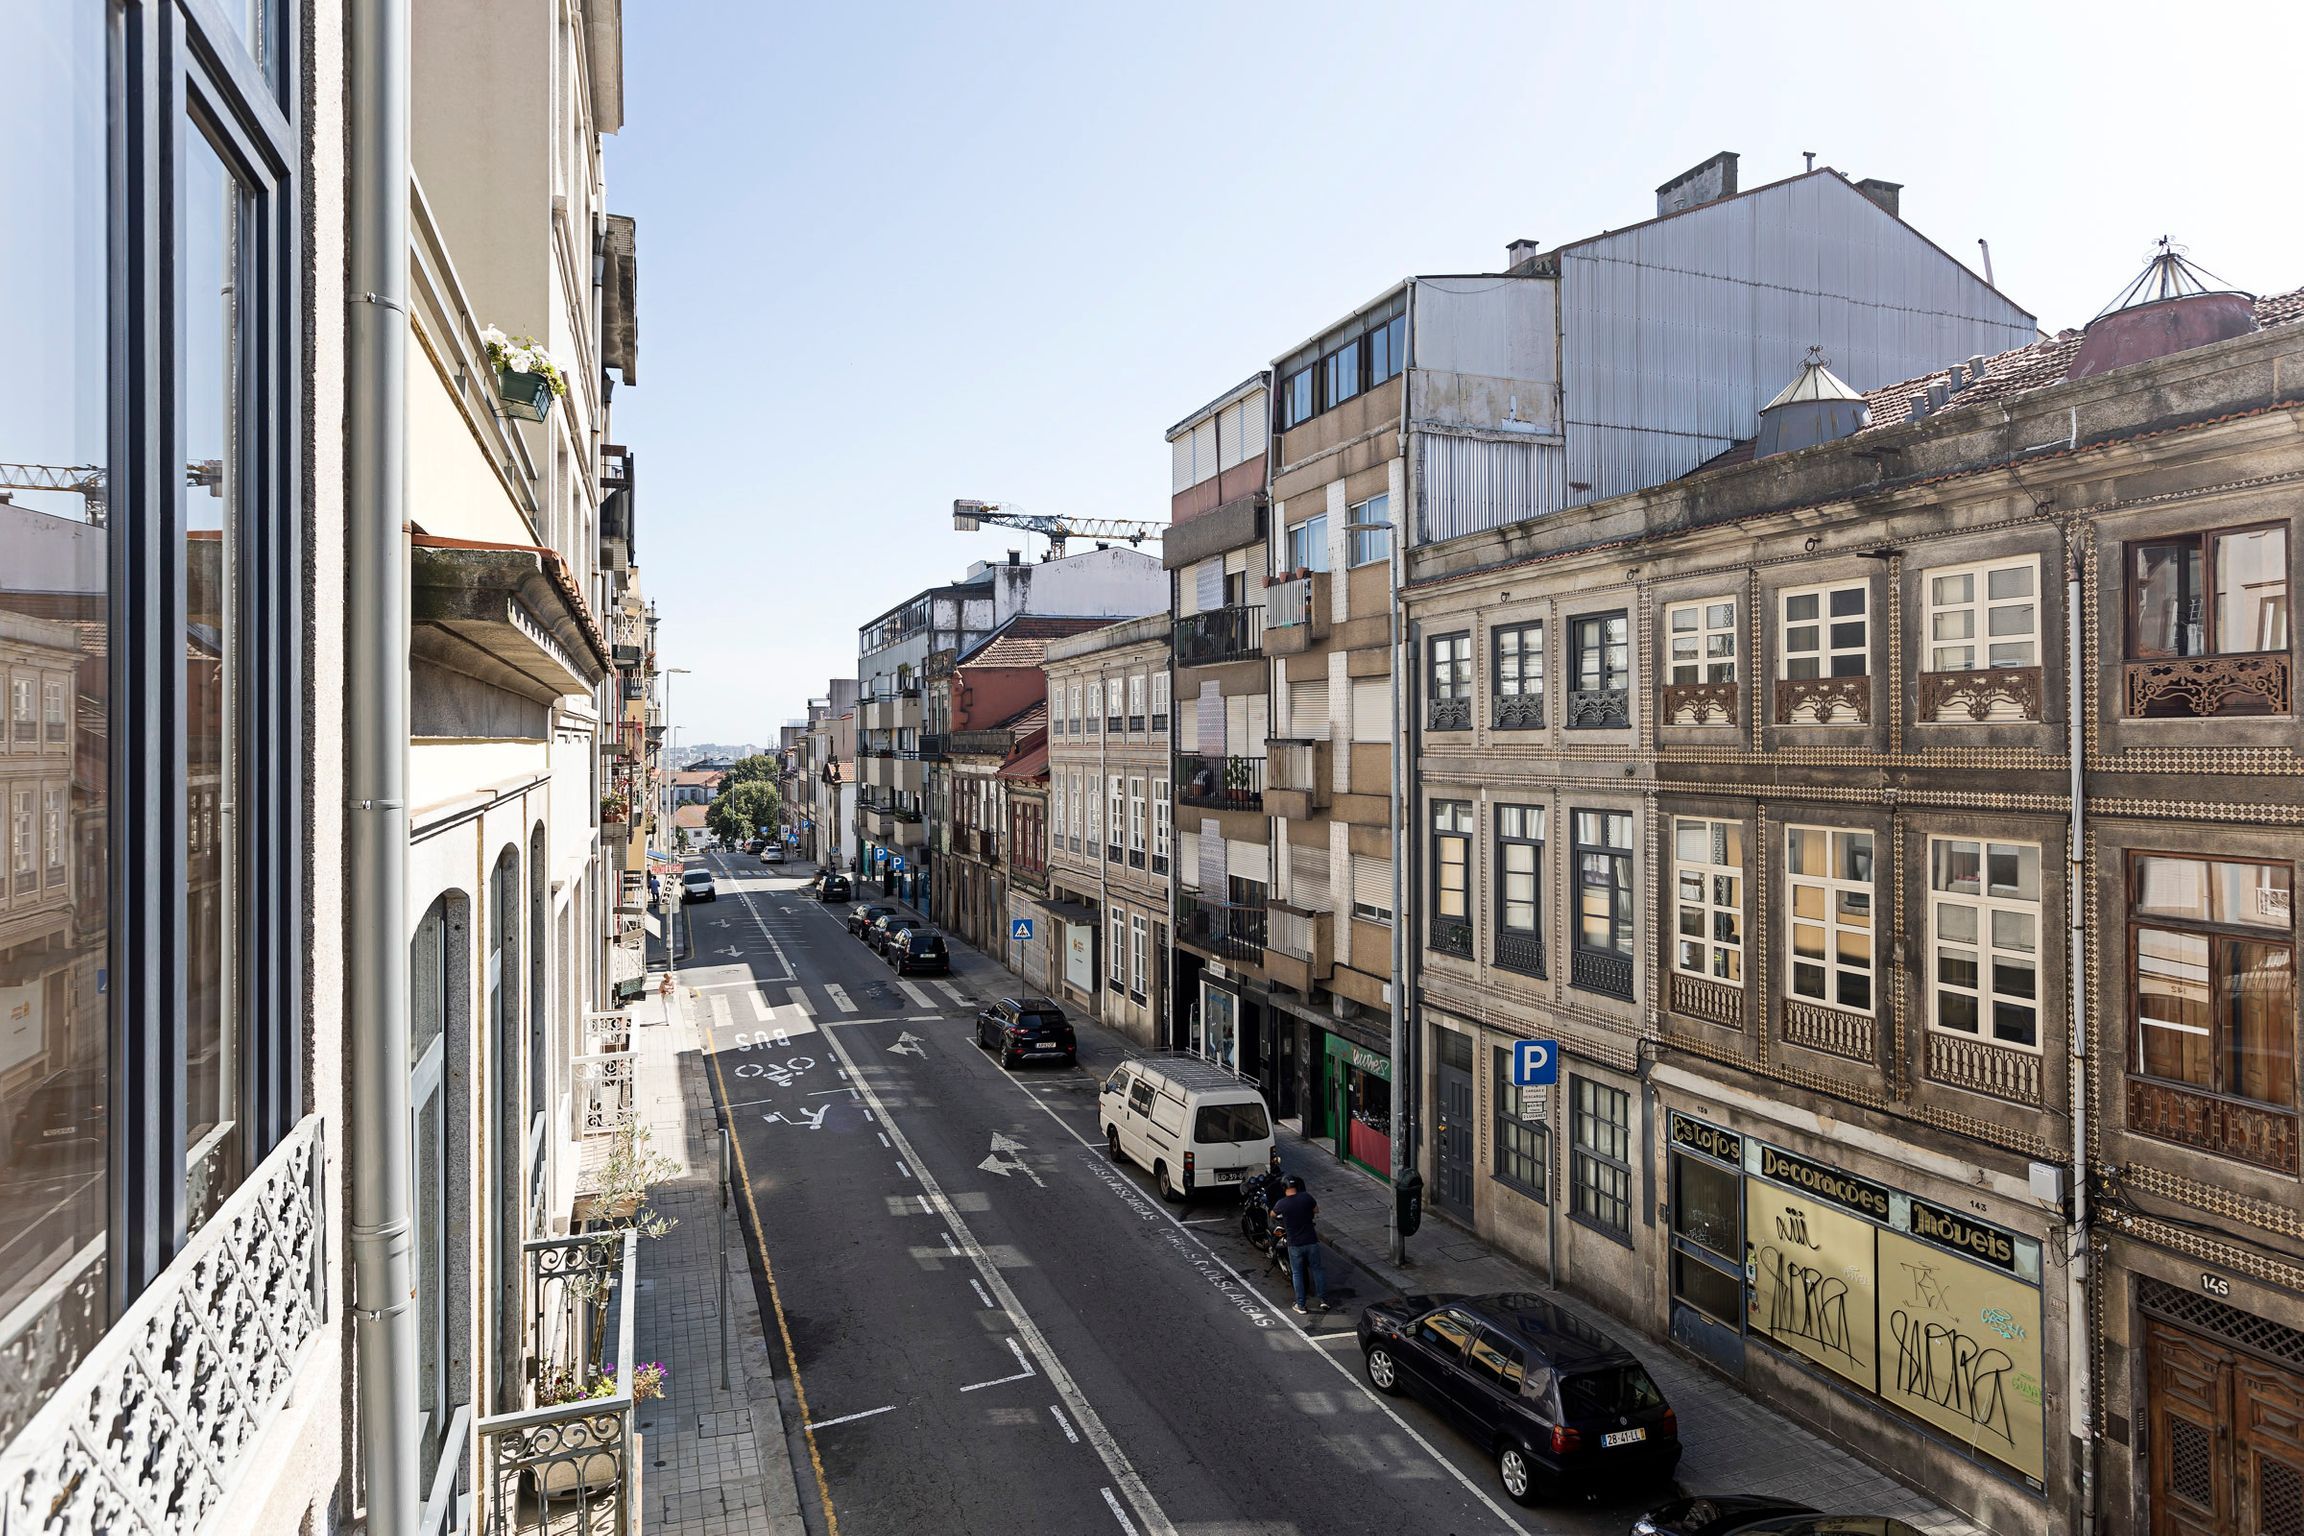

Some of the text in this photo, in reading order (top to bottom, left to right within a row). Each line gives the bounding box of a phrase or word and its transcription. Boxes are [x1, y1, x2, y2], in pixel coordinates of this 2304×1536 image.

[877, 849, 884, 859] P
[893, 858, 902, 869] P
[735, 1028, 791, 1052] BUS
[1524, 1046, 1548, 1081] P
[1673, 1116, 1740, 1159] Estofos
[1763, 1148, 1888, 1214] Decorações
[1969, 1200, 1987, 1212] 143
[2202, 1274, 2229, 1295] 145
[1202, 1269, 1276, 1327] DESCARGAS
